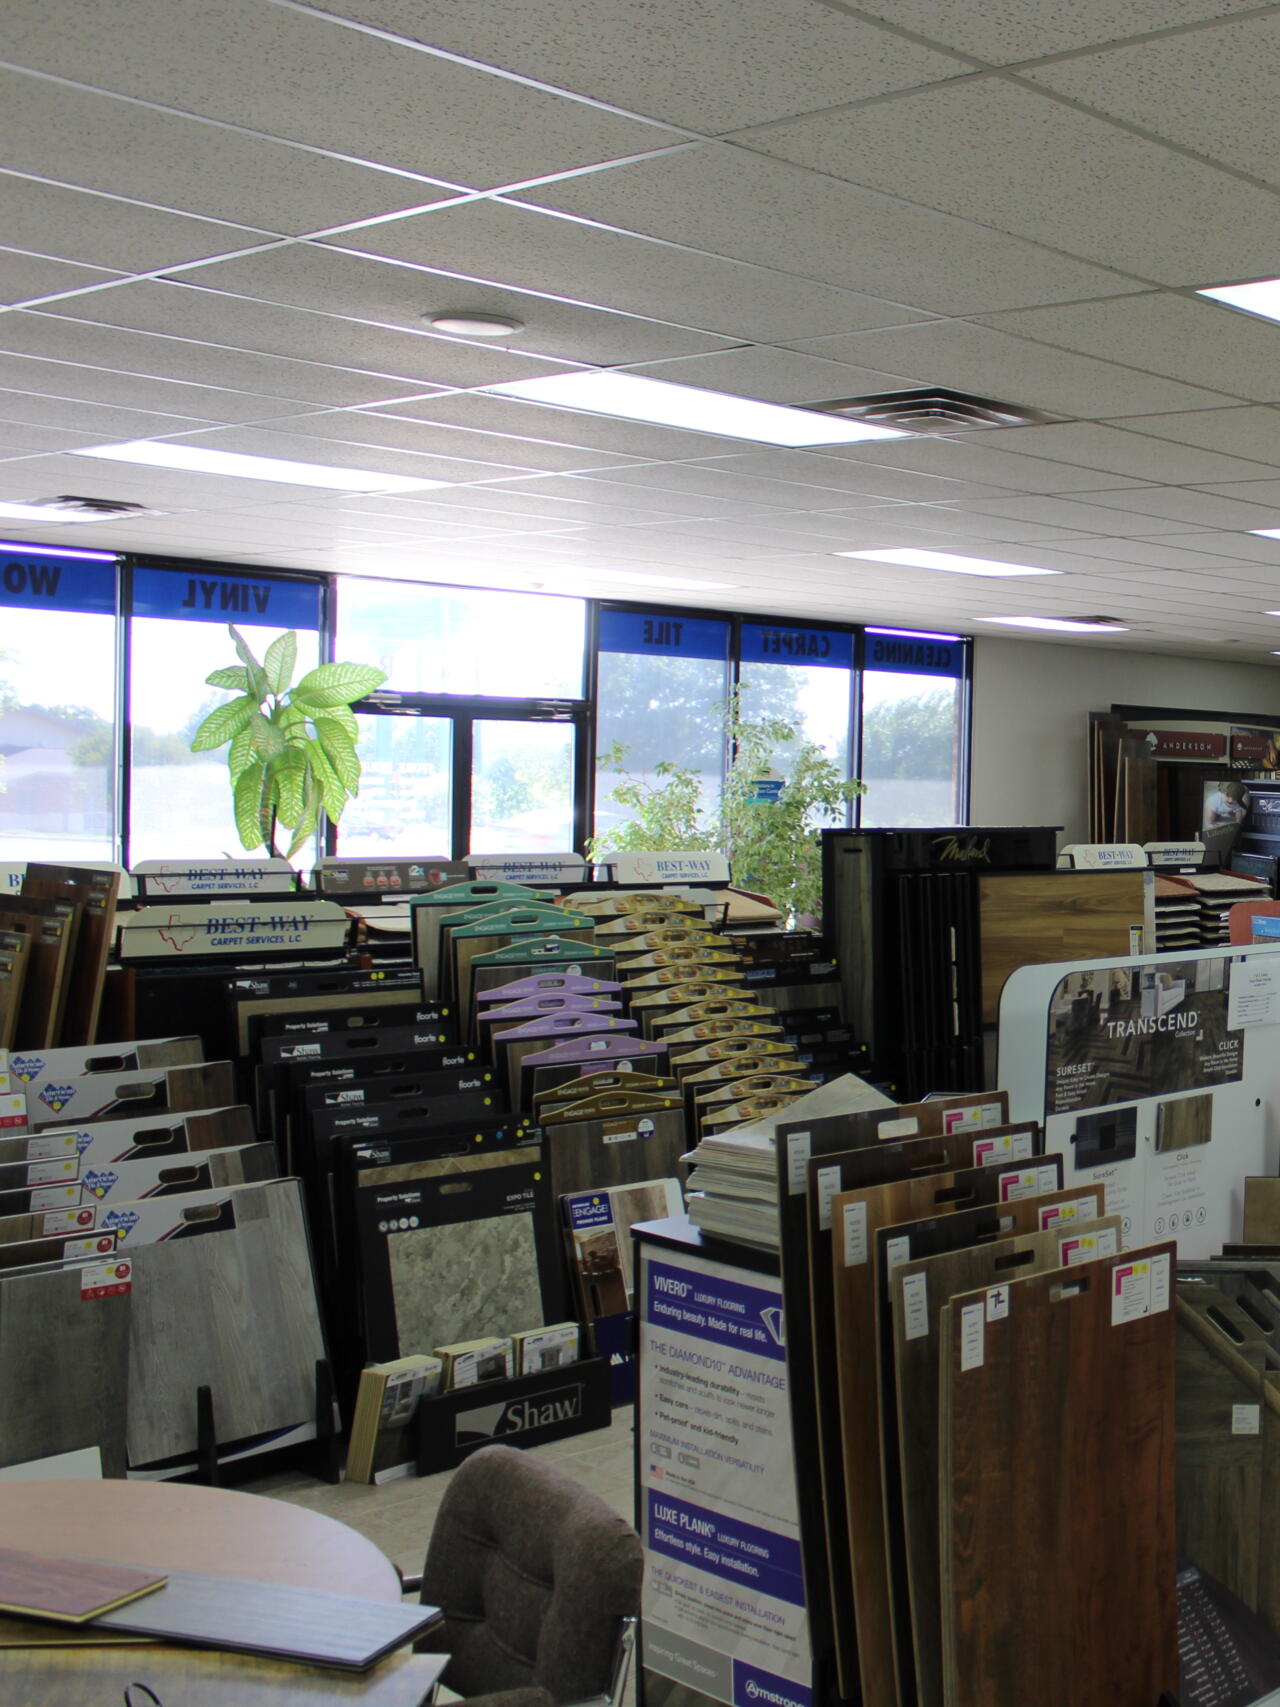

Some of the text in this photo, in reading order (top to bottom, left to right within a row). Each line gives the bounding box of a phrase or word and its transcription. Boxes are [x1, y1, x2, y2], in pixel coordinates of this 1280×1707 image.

[1162, 742, 1212, 751] ANDERSON
[1098, 850, 1134, 860] BEST-WAY
[655, 860, 712, 871] BEST-WAY
[187, 868, 267, 881] BEST-WAY
[191, 882, 216, 890] CARPET
[206, 914, 314, 935] BEST-WAY
[211, 937, 244, 947] CARPET
[1218, 1040, 1239, 1051] CLICK
[1176, 1153, 1188, 1162] Click
[84, 1175, 117, 1183] American
[506, 1191, 534, 1201] EXPO TILE
[573, 1203, 609, 1217] ENGAGE
[694, 1292, 716, 1306] LUXURY
[717, 1299, 745, 1314] FLOORING
[654, 1301, 767, 1343] Enduring beauty. Made for real life.
[650, 1340, 667, 1355] THE
[728, 1365, 785, 1390] ADVANTAGE
[659, 1365, 708, 1388] Industry-leading
[710, 1382, 740, 1397] durability
[659, 1394, 674, 1406] Easy
[676, 1399, 689, 1410] care
[505, 1397, 577, 1434] Shaw
[690, 1420, 702, 1432] and
[704, 1425, 740, 1445] kid-friendly
[681, 1440, 723, 1462] INSTALLATION
[724, 1452, 765, 1474] VERSATILITY
[654, 1503, 677, 1525] LUXE
[717, 1532, 739, 1548] LUXURY
[741, 1541, 769, 1559] FLOORING
[654, 1528, 760, 1577] Effortless style. Easy installation.
[652, 1566, 785, 1625] THE QUICKEST & EASIEST INSTALLATION
